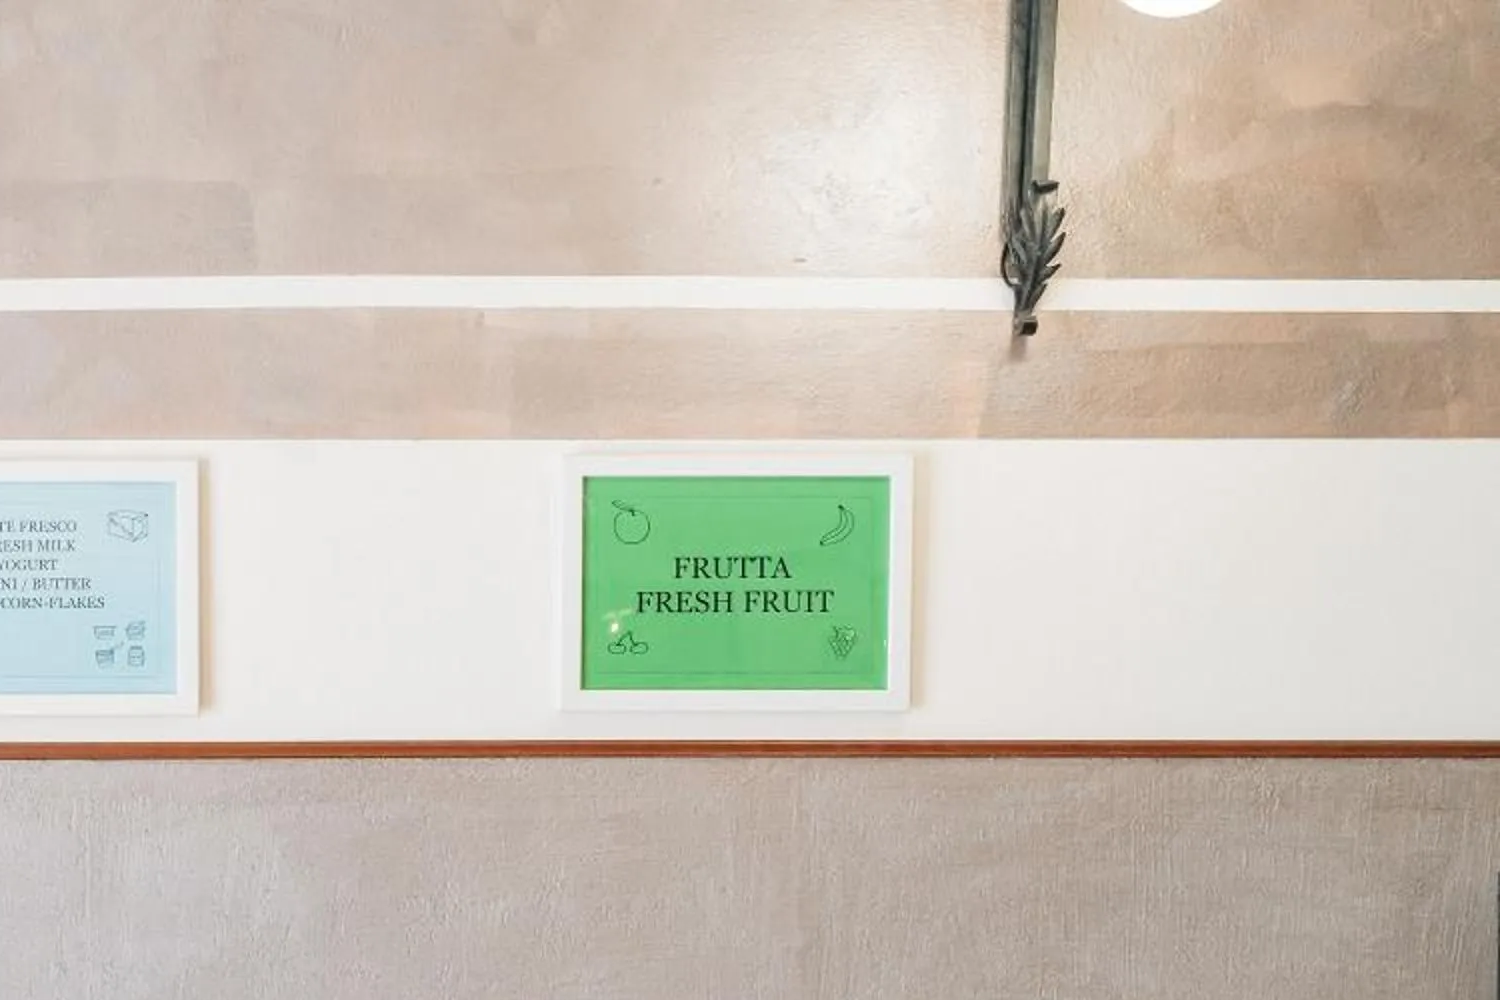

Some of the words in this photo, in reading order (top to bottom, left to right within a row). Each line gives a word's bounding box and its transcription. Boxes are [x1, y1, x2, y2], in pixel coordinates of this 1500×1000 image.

[19, 520, 78, 533] FRESCO
[37, 539, 76, 551] MILK
[674, 556, 793, 580] FRUTTA
[33, 578, 92, 590] BUTTER
[636, 590, 733, 613] FRESH
[744, 590, 835, 612] FRUIT
